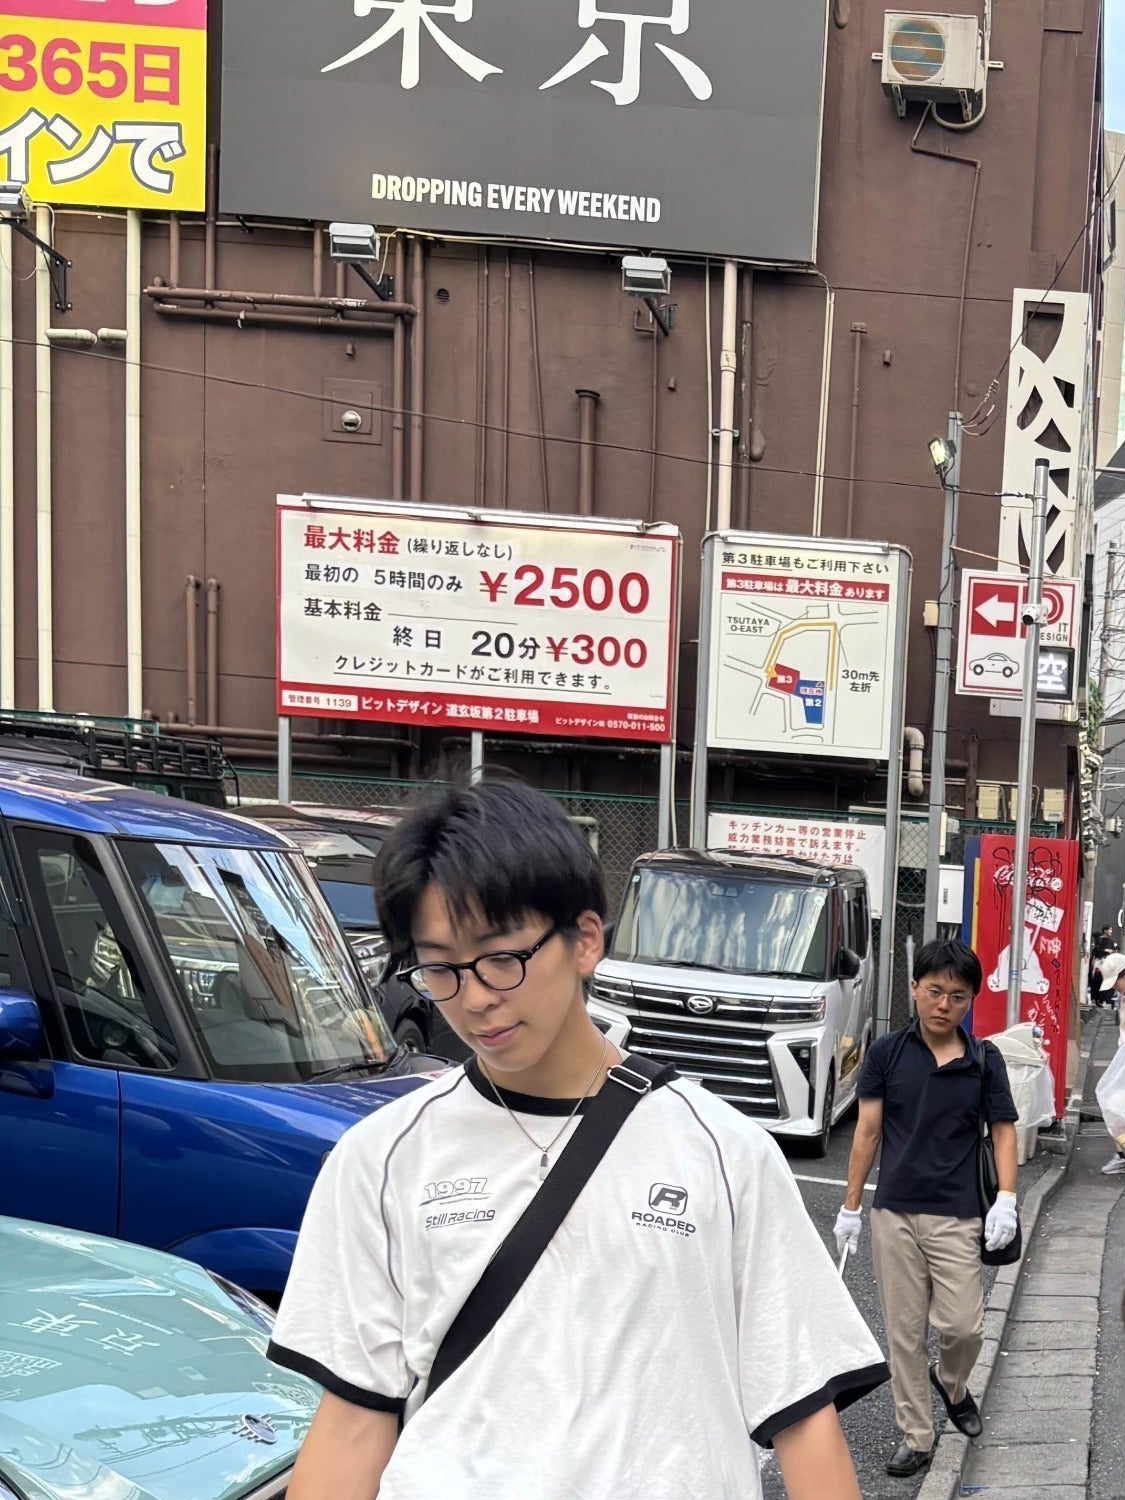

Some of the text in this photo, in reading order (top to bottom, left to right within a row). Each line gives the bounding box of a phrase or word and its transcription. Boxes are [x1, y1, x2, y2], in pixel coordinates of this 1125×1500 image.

[0, 34, 180, 105] 365日
[0, 107, 186, 193] インで
[372, 174, 661, 223] DROPPING EVERY WEEKEND
[304, 525, 513, 561] 最大料金 (繰り返しなし)
[722, 552, 889, 574] 第3駐車場もご利用下さい
[305, 564, 650, 614] 最初の 5時間のみ ¥2500
[726, 578, 886, 600] 第3駐車場は 最大料金 あります
[304, 598, 383, 622] 基本料金
[726, 616, 770, 627] TSUTAYA
[730, 624, 764, 634] O-EAST
[1040, 632, 1068, 642] ESIGN
[393, 626, 648, 669] 終日 20分 ¥300
[335, 655, 610, 691] クレジットカードがご利用できます。
[841, 669, 880, 682] 30m先
[849, 682, 872, 693] 左折
[288, 694, 321, 705] 管理番号
[326, 697, 352, 708] 1139
[446, 703, 540, 724] 道玄坂第2駐車場
[728, 820, 867, 841] キッチンカー等の営業停止
[424, 1177, 488, 1200] 1997
[447, 1209, 496, 1224] Racing
[631, 1210, 697, 1235] ROADED
[635, 1221, 690, 1238] RACING CLUB
